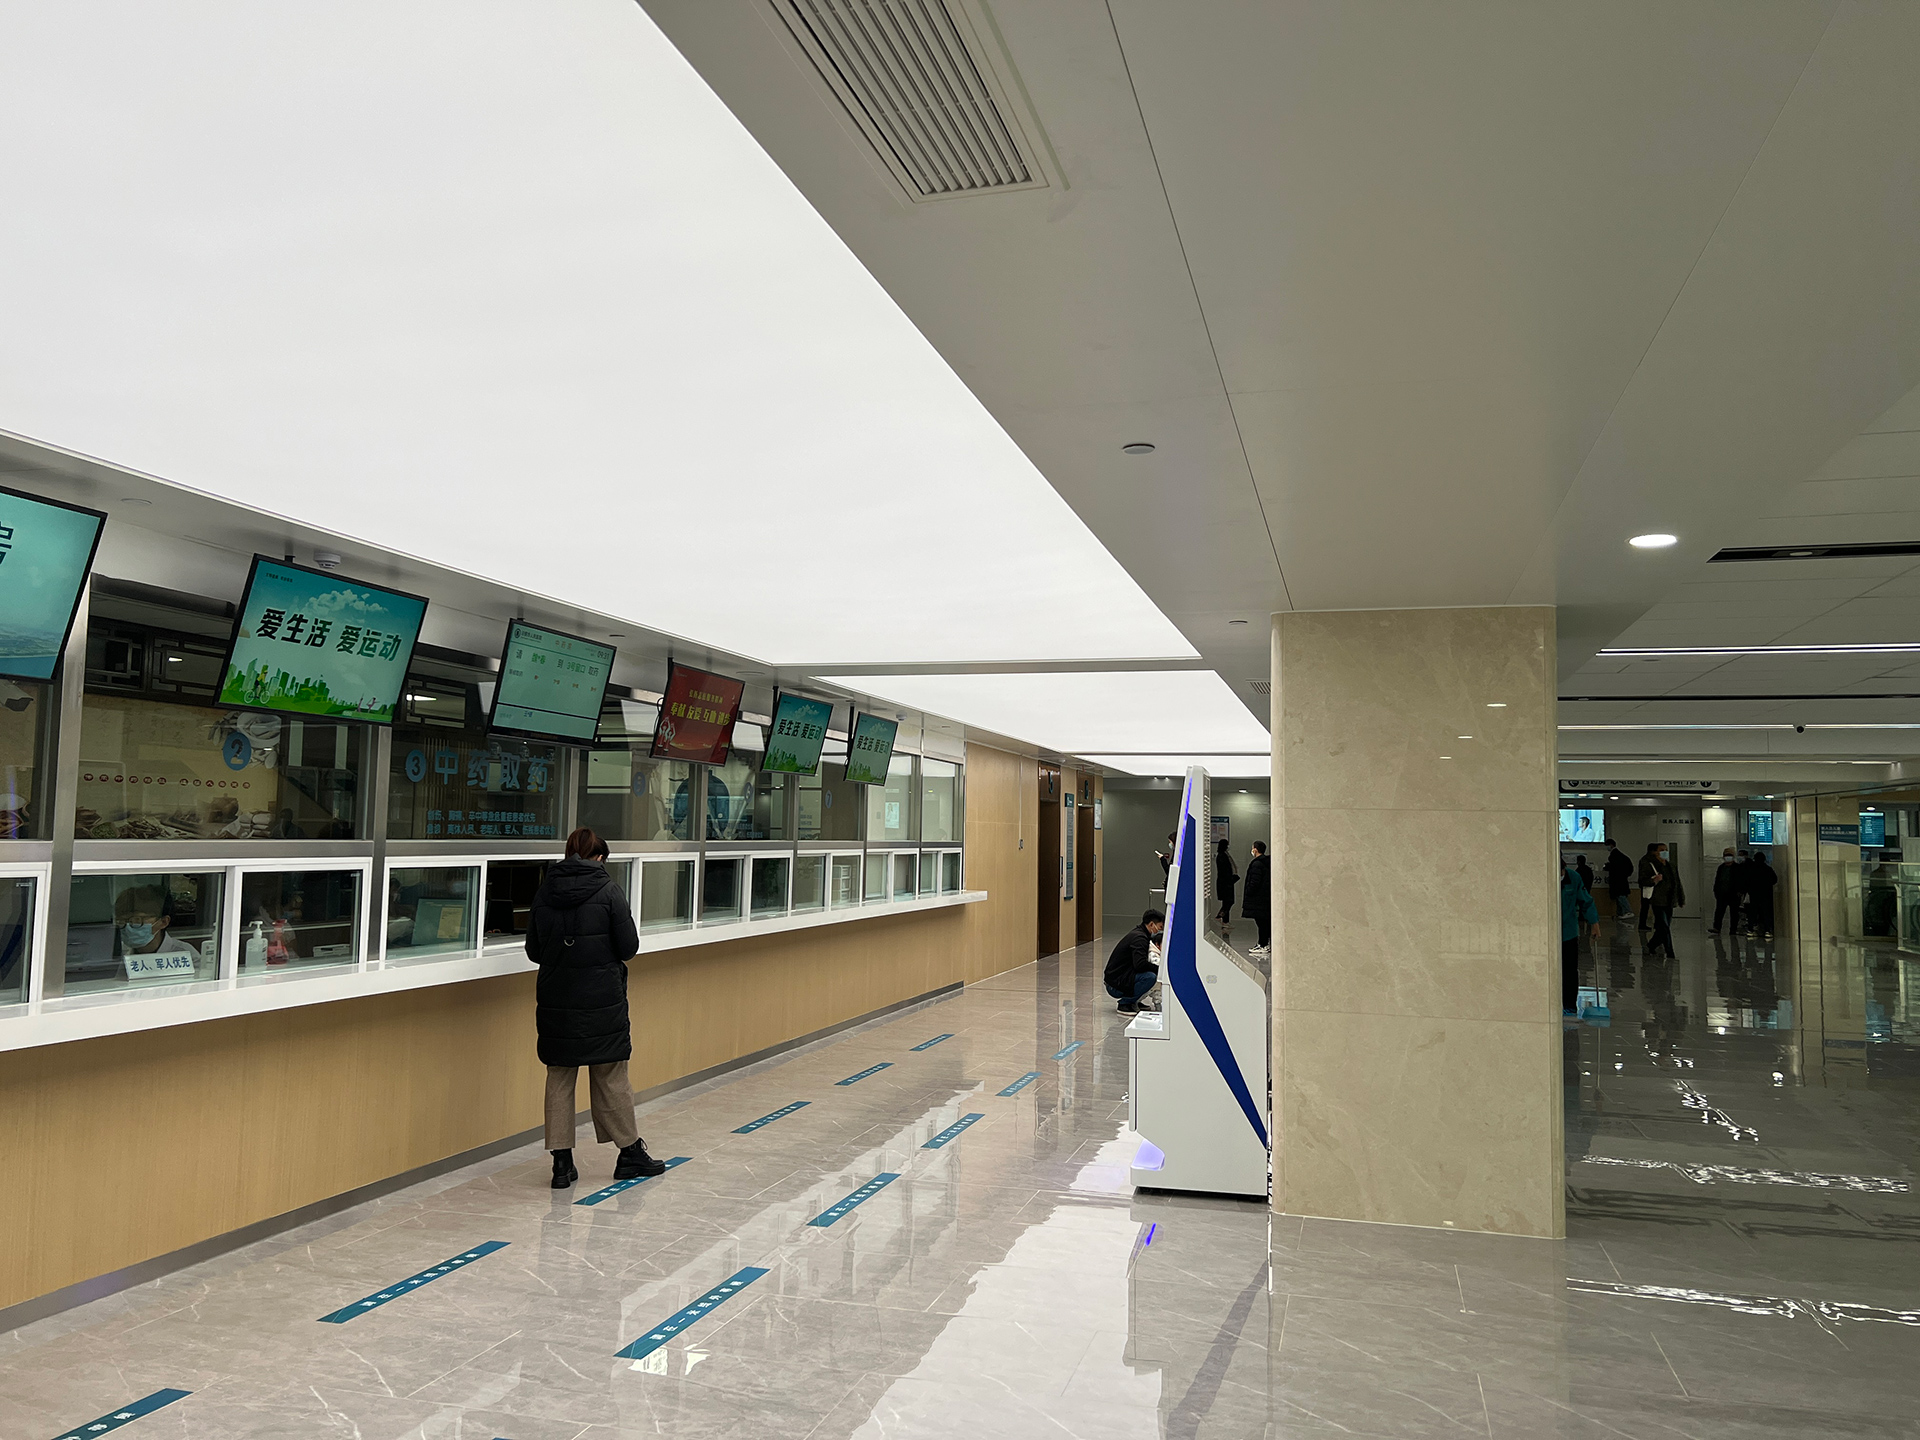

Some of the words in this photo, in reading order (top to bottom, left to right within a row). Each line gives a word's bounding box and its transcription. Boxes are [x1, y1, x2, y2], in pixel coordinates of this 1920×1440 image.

[256, 608, 333, 647] 爱生活
[336, 624, 402, 661] 爱运动
[777, 719, 801, 737] 爱生活
[801, 723, 822, 741] 爱运动
[435, 746, 548, 792] 中药取药
[130, 956, 191, 972] 老人、军人优先
